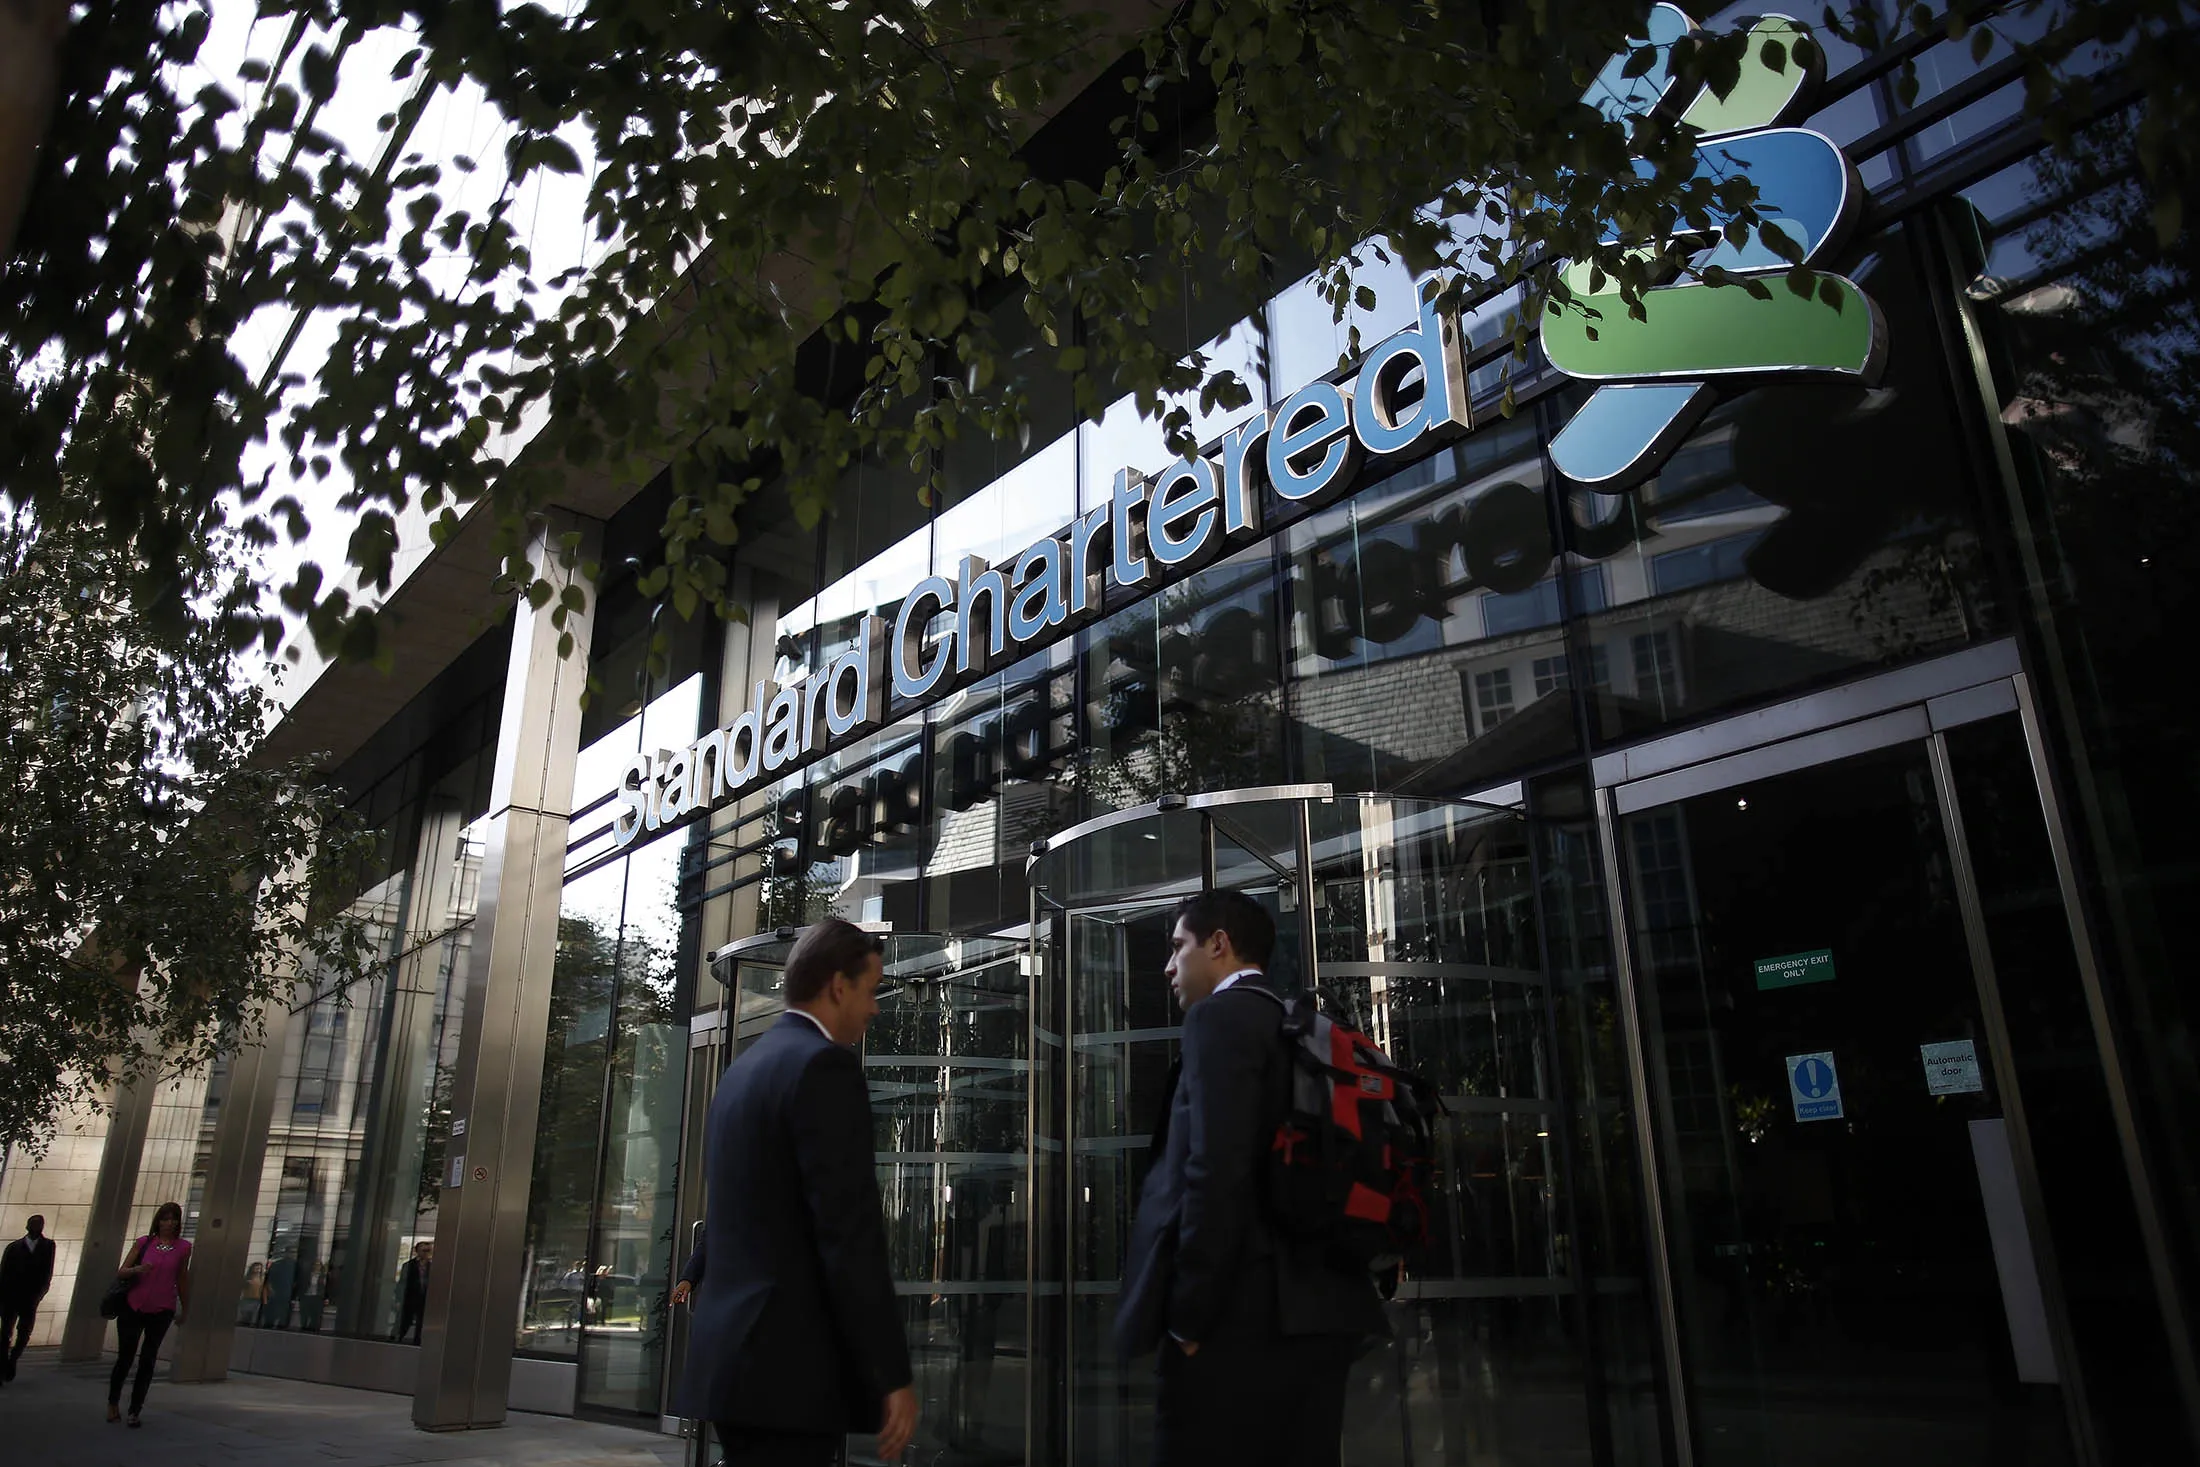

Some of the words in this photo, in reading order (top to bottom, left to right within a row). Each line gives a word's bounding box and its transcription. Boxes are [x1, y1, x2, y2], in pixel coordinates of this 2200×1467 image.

[613, 614, 876, 848] Standard
[892, 274, 1458, 699] Chartered
[1758, 958, 1809, 973] EMERGENCY
[1810, 954, 1829, 965] EXIT
[1783, 968, 1806, 978] ONLY
[1927, 1054, 1973, 1066] Automatic
[1941, 1068, 1962, 1076] door
